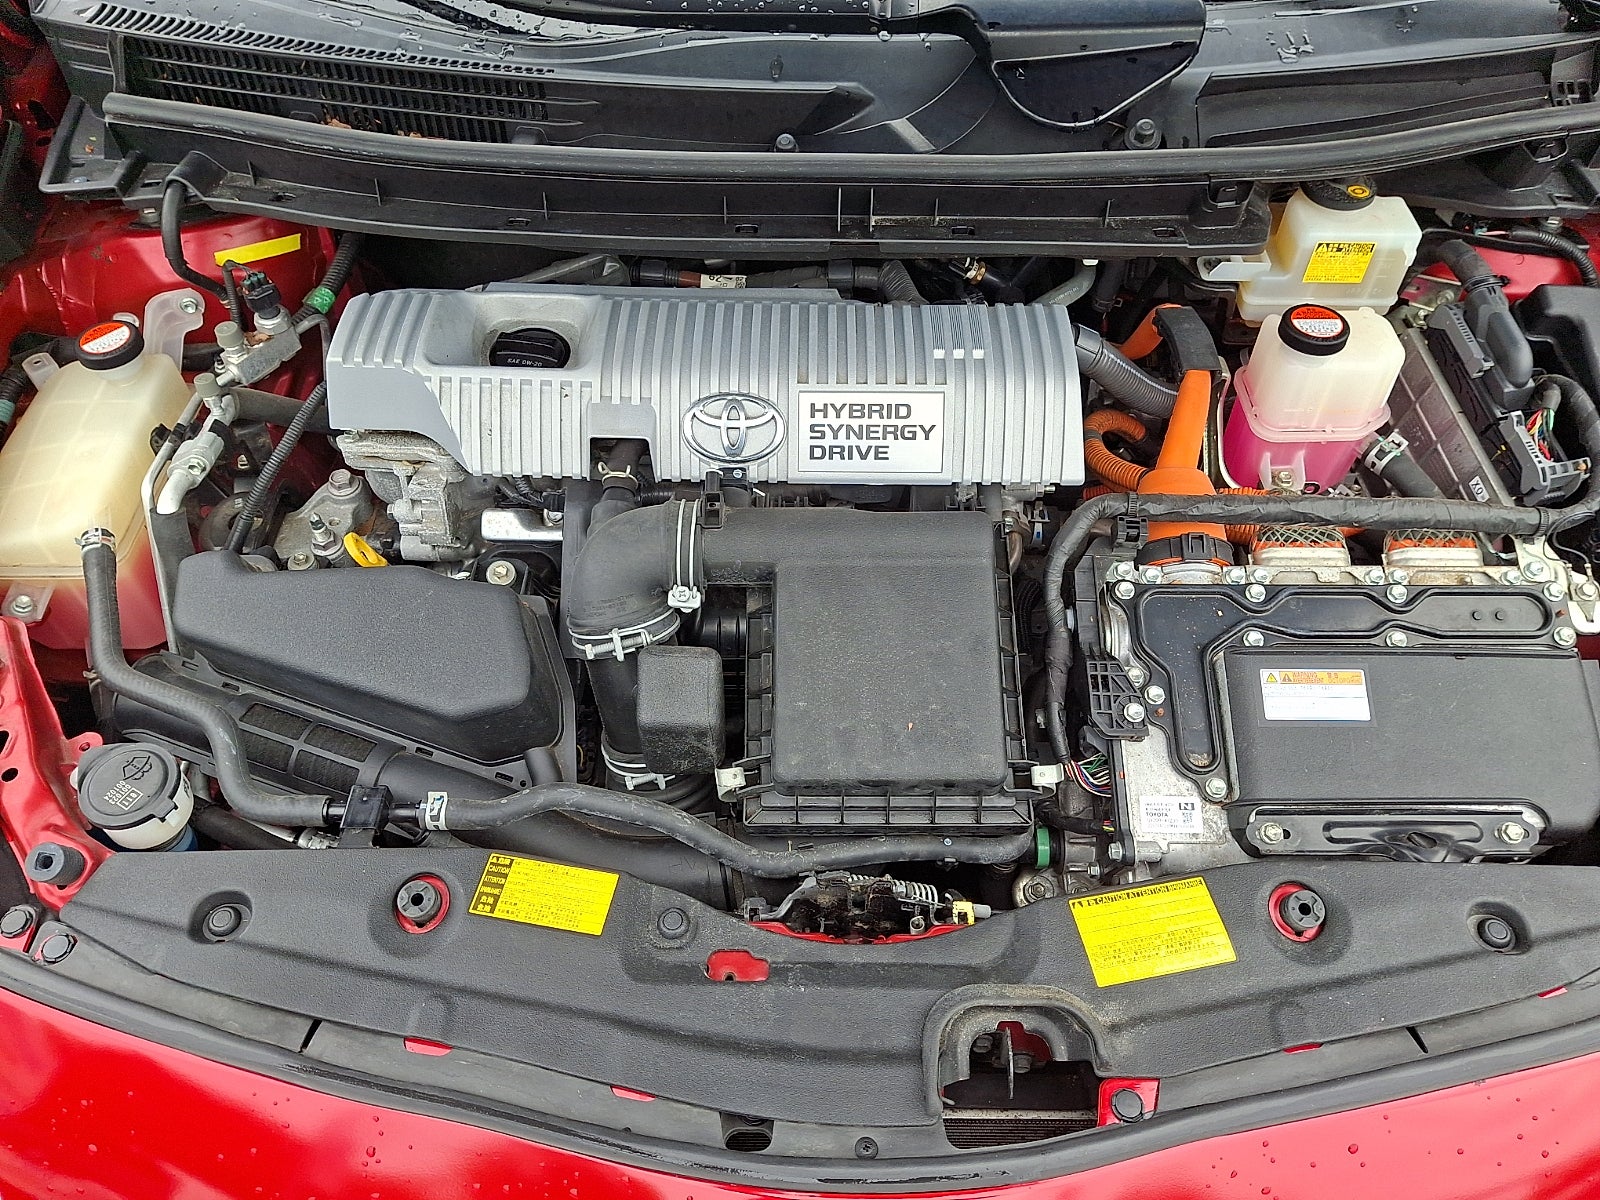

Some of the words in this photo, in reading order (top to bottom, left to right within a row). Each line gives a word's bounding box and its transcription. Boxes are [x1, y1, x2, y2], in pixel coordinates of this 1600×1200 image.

[810, 403, 912, 419] HYBRID
[809, 424, 937, 440] SYNERGY
[809, 445, 890, 460] DRIVE
[1098, 893, 1127, 904] CAUTION
[1129, 886, 1167, 899] ATTENTION
